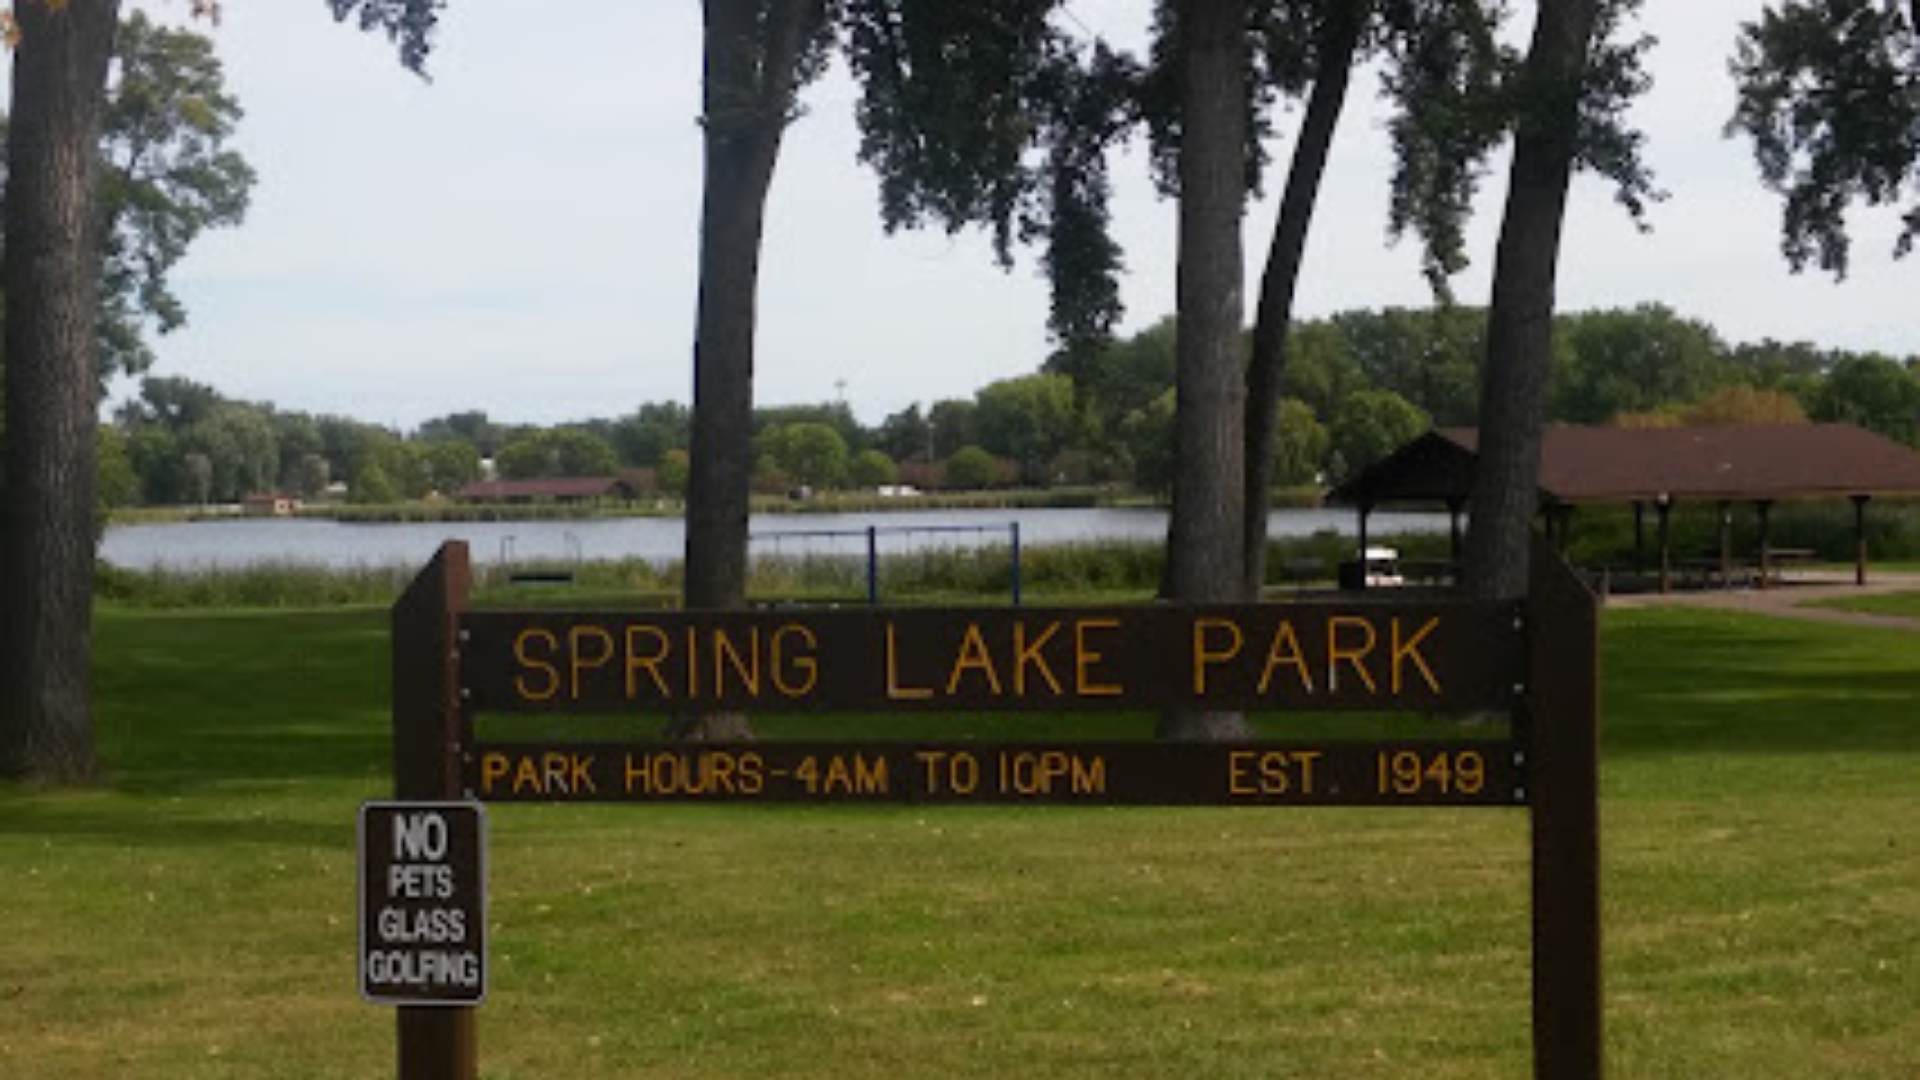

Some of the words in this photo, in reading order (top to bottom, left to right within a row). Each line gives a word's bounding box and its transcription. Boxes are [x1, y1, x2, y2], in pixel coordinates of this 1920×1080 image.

[512, 622, 819, 701] SPRING
[886, 617, 1123, 698] LAKE
[1192, 615, 1442, 696] PARK
[481, 752, 597, 794] PARK
[916, 751, 979, 795] TO
[998, 751, 1106, 793] 10PM
[1377, 751, 1485, 794] 1949
[393, 813, 448, 861] NO
[388, 864, 453, 898] PETS
[378, 907, 466, 942] GLASS
[367, 950, 479, 986] GOLFING
